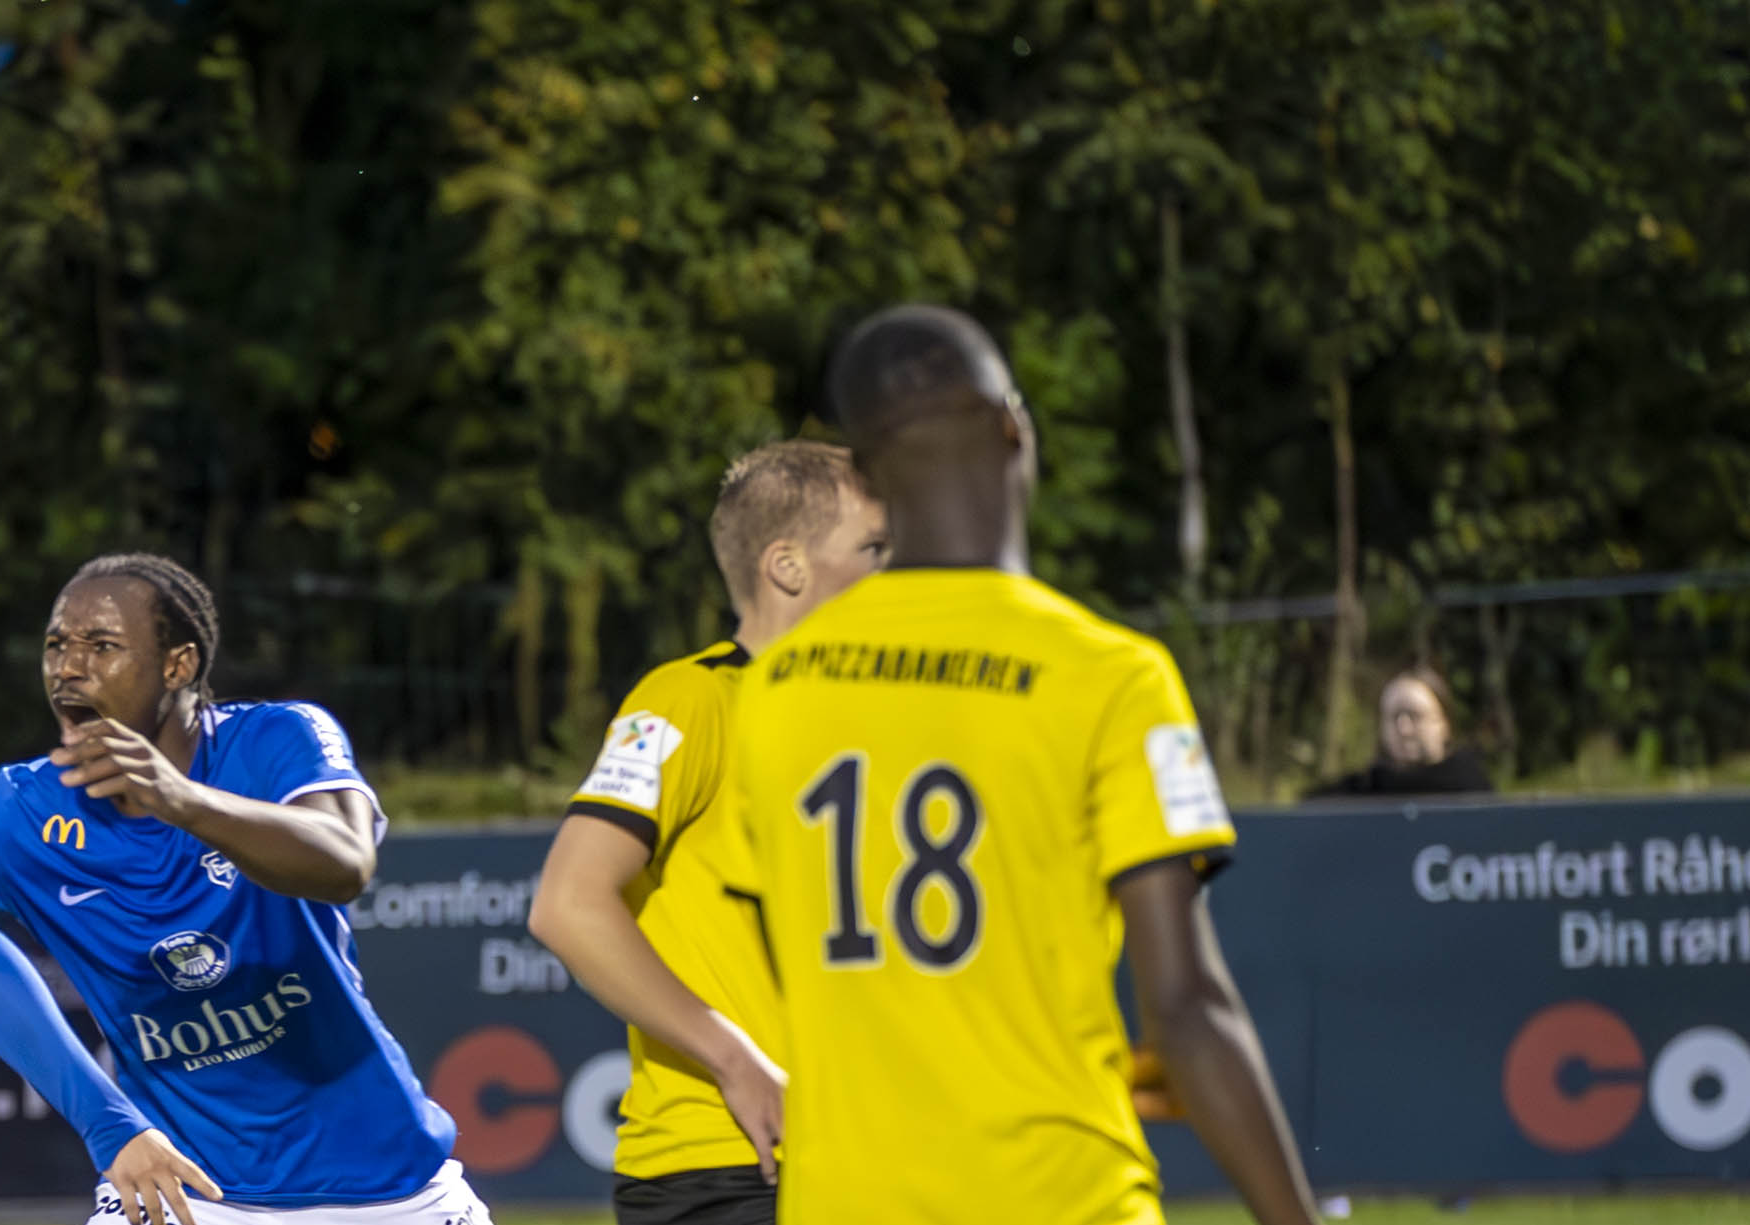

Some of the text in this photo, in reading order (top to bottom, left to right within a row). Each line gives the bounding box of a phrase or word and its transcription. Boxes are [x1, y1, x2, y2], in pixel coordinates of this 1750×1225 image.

[800, 750, 986, 975] 18
[1412, 840, 1633, 902] Comfort
[350, 870, 541, 930] Comfor
[480, 937, 570, 994] Din
[1558, 908, 1650, 969] Din
[130, 972, 312, 1062] Bohus
